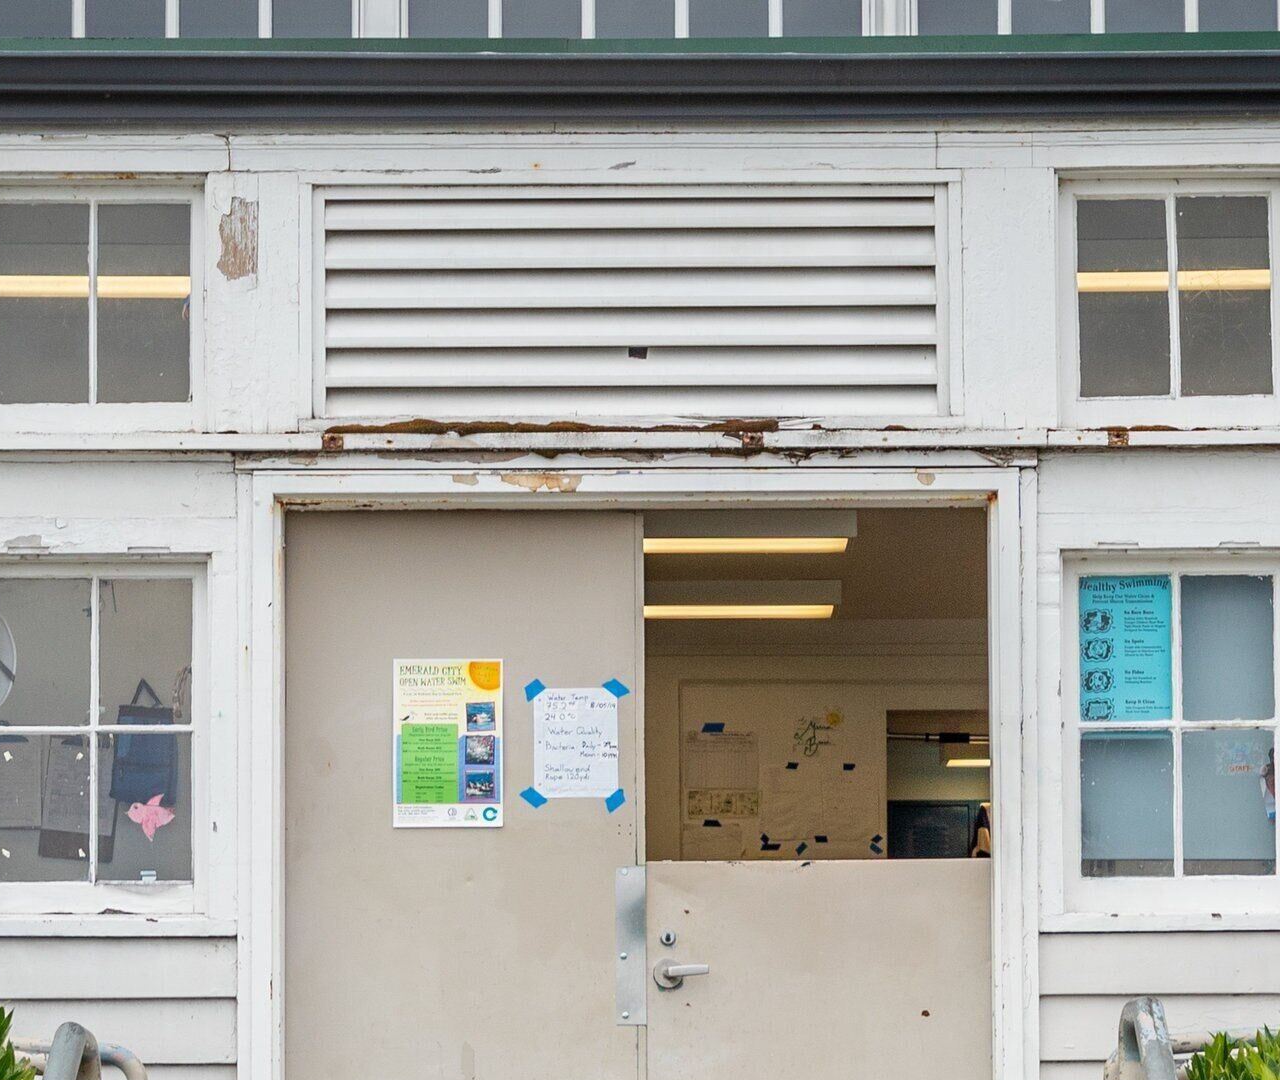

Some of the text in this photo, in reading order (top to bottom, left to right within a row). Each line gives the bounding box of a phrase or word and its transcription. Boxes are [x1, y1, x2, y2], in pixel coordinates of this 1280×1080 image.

[1080, 578, 1169, 593] Healthy Swimming
[399, 664, 439, 676] EMERALD
[441, 664, 462, 676] CITY
[399, 677, 467, 687] OPEN WATER SWIM
[547, 693, 589, 702] Water Temp
[547, 726, 603, 738] Water Quality
[545, 742, 575, 750] Bacteria
[544, 764, 591, 773] Shallow end
[545, 773, 563, 782] Rope
